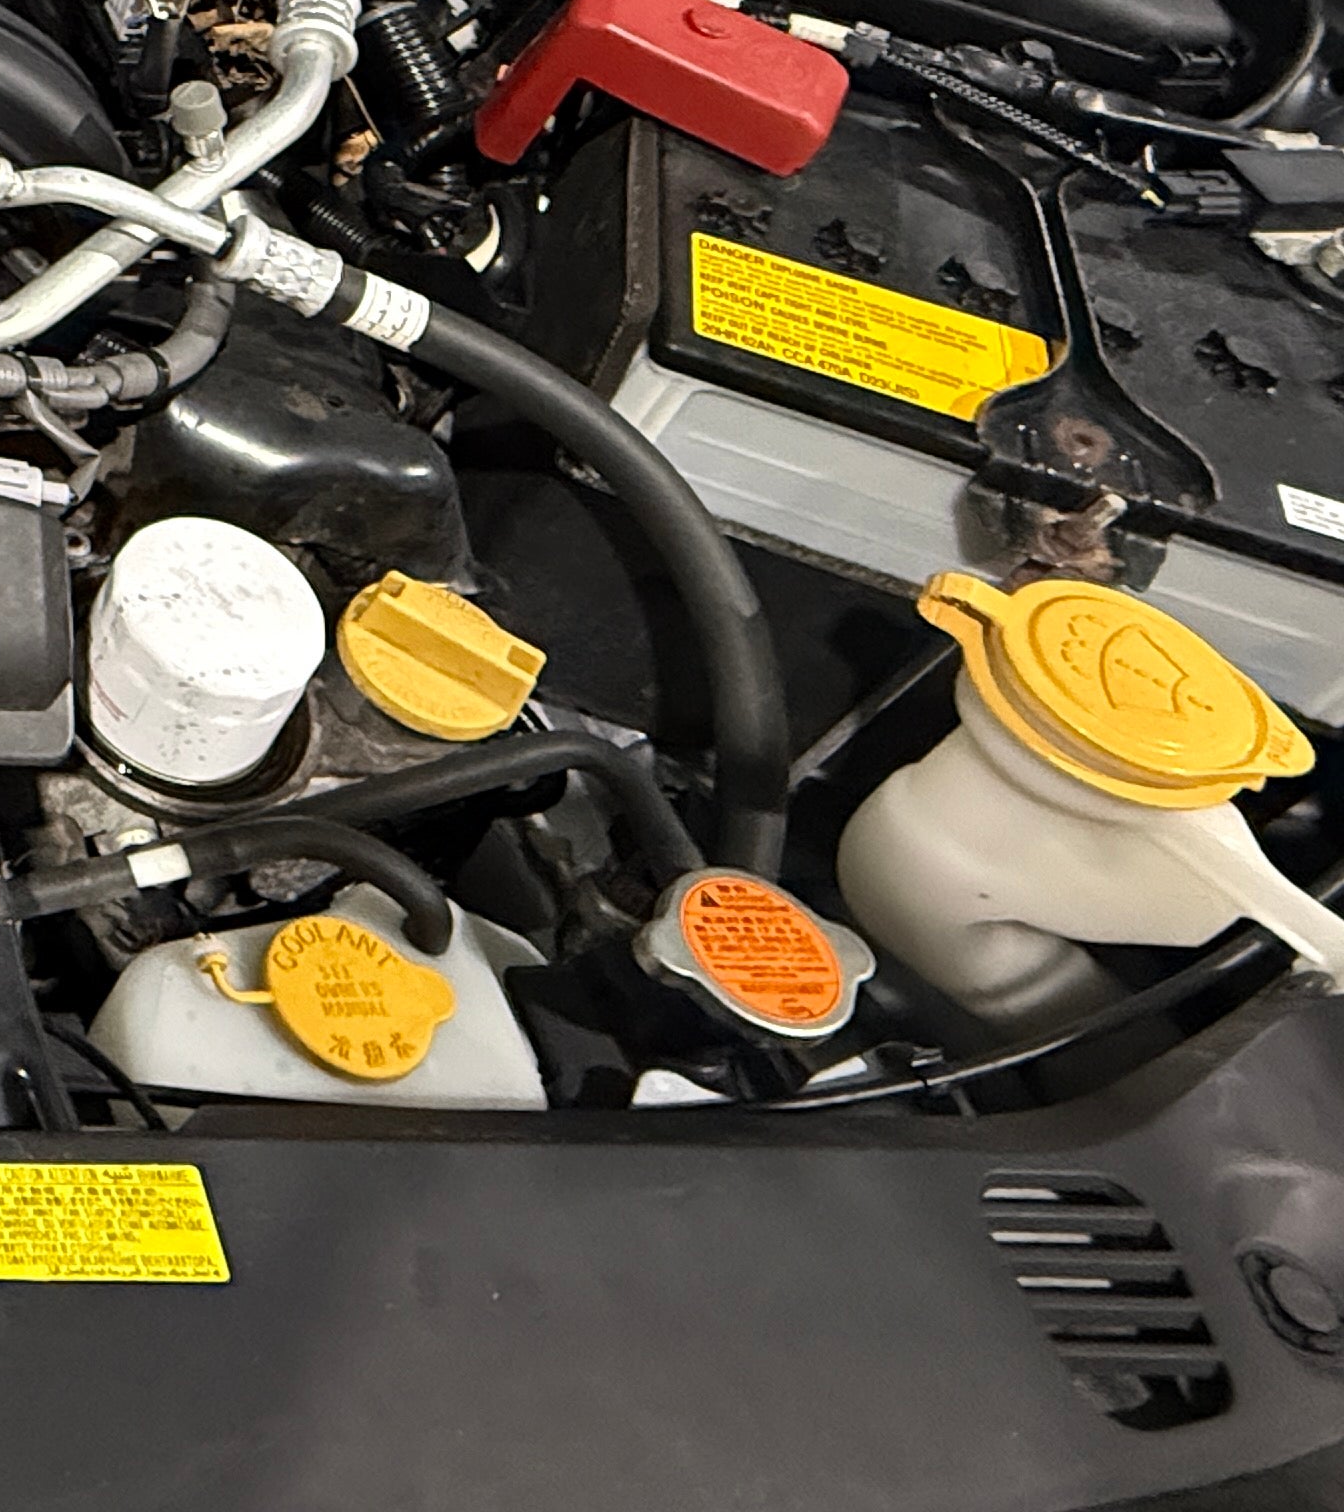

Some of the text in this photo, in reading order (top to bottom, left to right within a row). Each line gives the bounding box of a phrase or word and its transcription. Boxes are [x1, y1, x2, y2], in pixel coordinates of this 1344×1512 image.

[699, 239, 764, 265] DANGER
[700, 284, 765, 310] POISON
[782, 348, 814, 365] CCA
[272, 921, 399, 971] COOLANT
